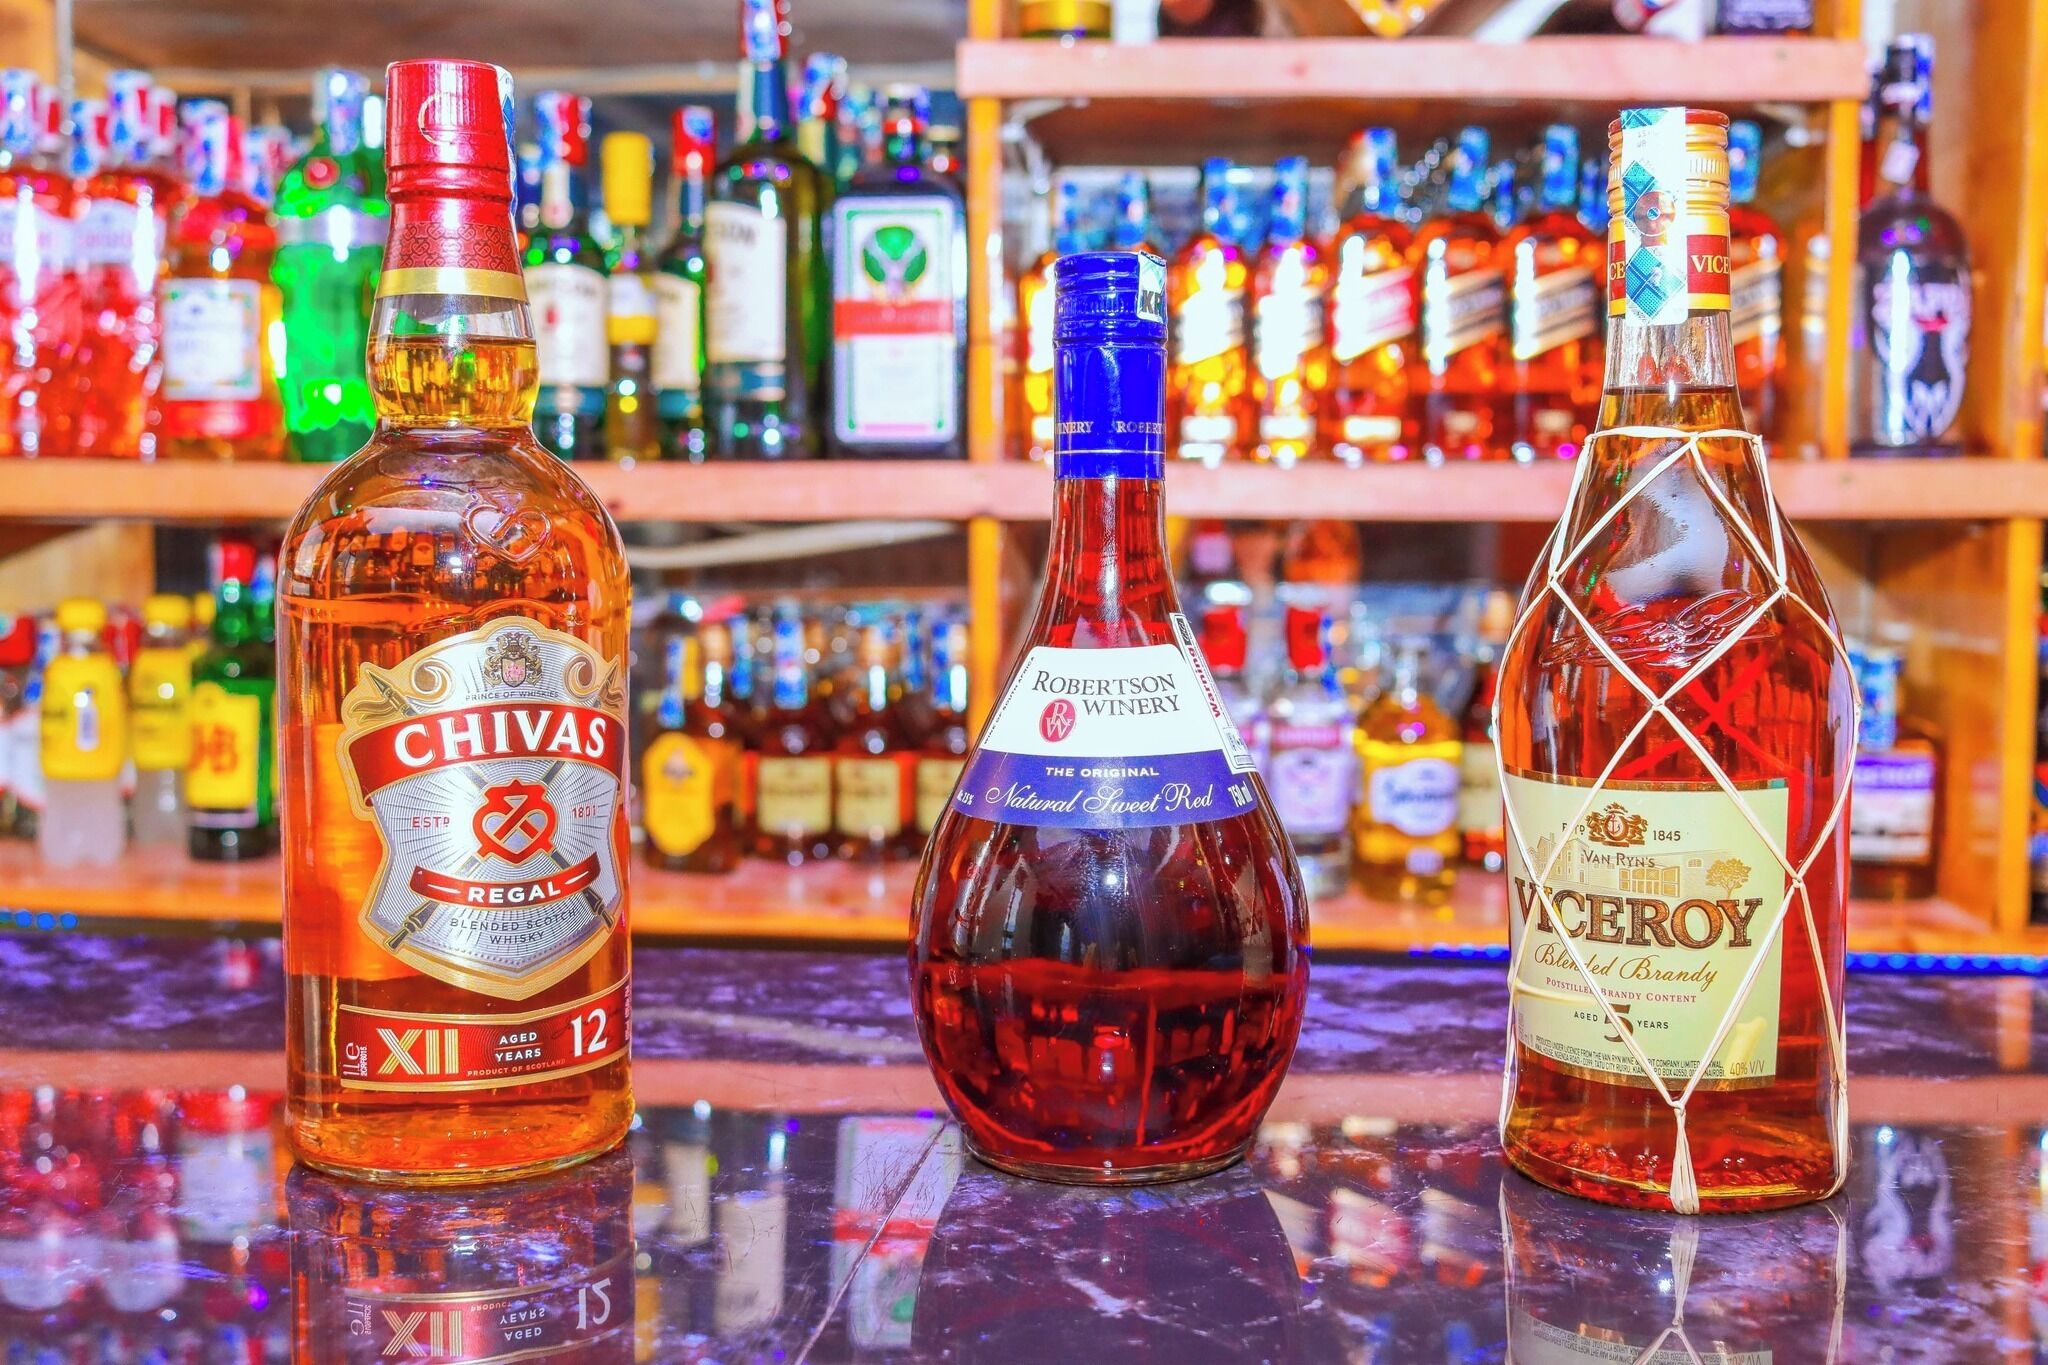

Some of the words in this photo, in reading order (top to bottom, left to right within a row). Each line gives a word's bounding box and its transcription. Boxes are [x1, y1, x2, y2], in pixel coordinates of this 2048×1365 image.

[1002, 684, 1019, 711] SOUTH
[1017, 656, 1035, 683] AFRICA
[1032, 670, 1177, 696] ROBERTSON
[1188, 647, 1222, 719] Warning
[465, 691, 500, 701] PRINCE
[502, 691, 517, 699] OF
[518, 690, 559, 699] WHISKIES
[1082, 694, 1182, 717] WINERY
[394, 710, 607, 767] CHIVAS
[1045, 767, 1074, 777] THE
[1080, 767, 1160, 778] ORIGINAL
[985, 782, 1076, 813] Natural
[1082, 785, 1160, 814] Sweet
[1160, 783, 1214, 812] Red
[572, 806, 598, 819] 1801
[1652, 830, 1681, 842] 1845
[1583, 850, 1610, 866] VAN
[1615, 852, 1656, 869] RYN'S
[467, 881, 562, 904] REGAL
[450, 918, 520, 931] BLENDED
[526, 909, 577, 930] SCOTCH
[1514, 876, 1763, 949] VICEROY
[489, 931, 546, 945] WHISKY
[1534, 943, 1618, 977] Blended
[1619, 954, 1719, 992] Brandy
[1600, 988, 1642, 1001] BRANDY
[1646, 991, 1697, 1003] CONTENT
[1573, 1010, 1599, 1022] AGED
[1603, 1003, 1635, 1043] 5
[1636, 1019, 1670, 1030] YEARS
[499, 1031, 538, 1045] AGED
[570, 1007, 608, 1057] 12
[376, 1028, 459, 1075] XII
[494, 1047, 542, 1063] YEARS
[467, 1067, 509, 1077] PRODUCT
[511, 1064, 523, 1073] OF
[525, 1058, 566, 1071] SCOTLAND
[1621, 1056, 1634, 1065] WINE
[1656, 1059, 1680, 1068] COMPANY
[1729, 1060, 1748, 1075] 40%
[1749, 1059, 1765, 1075] V/V
[1662, 1068, 1673, 1076] BOX
